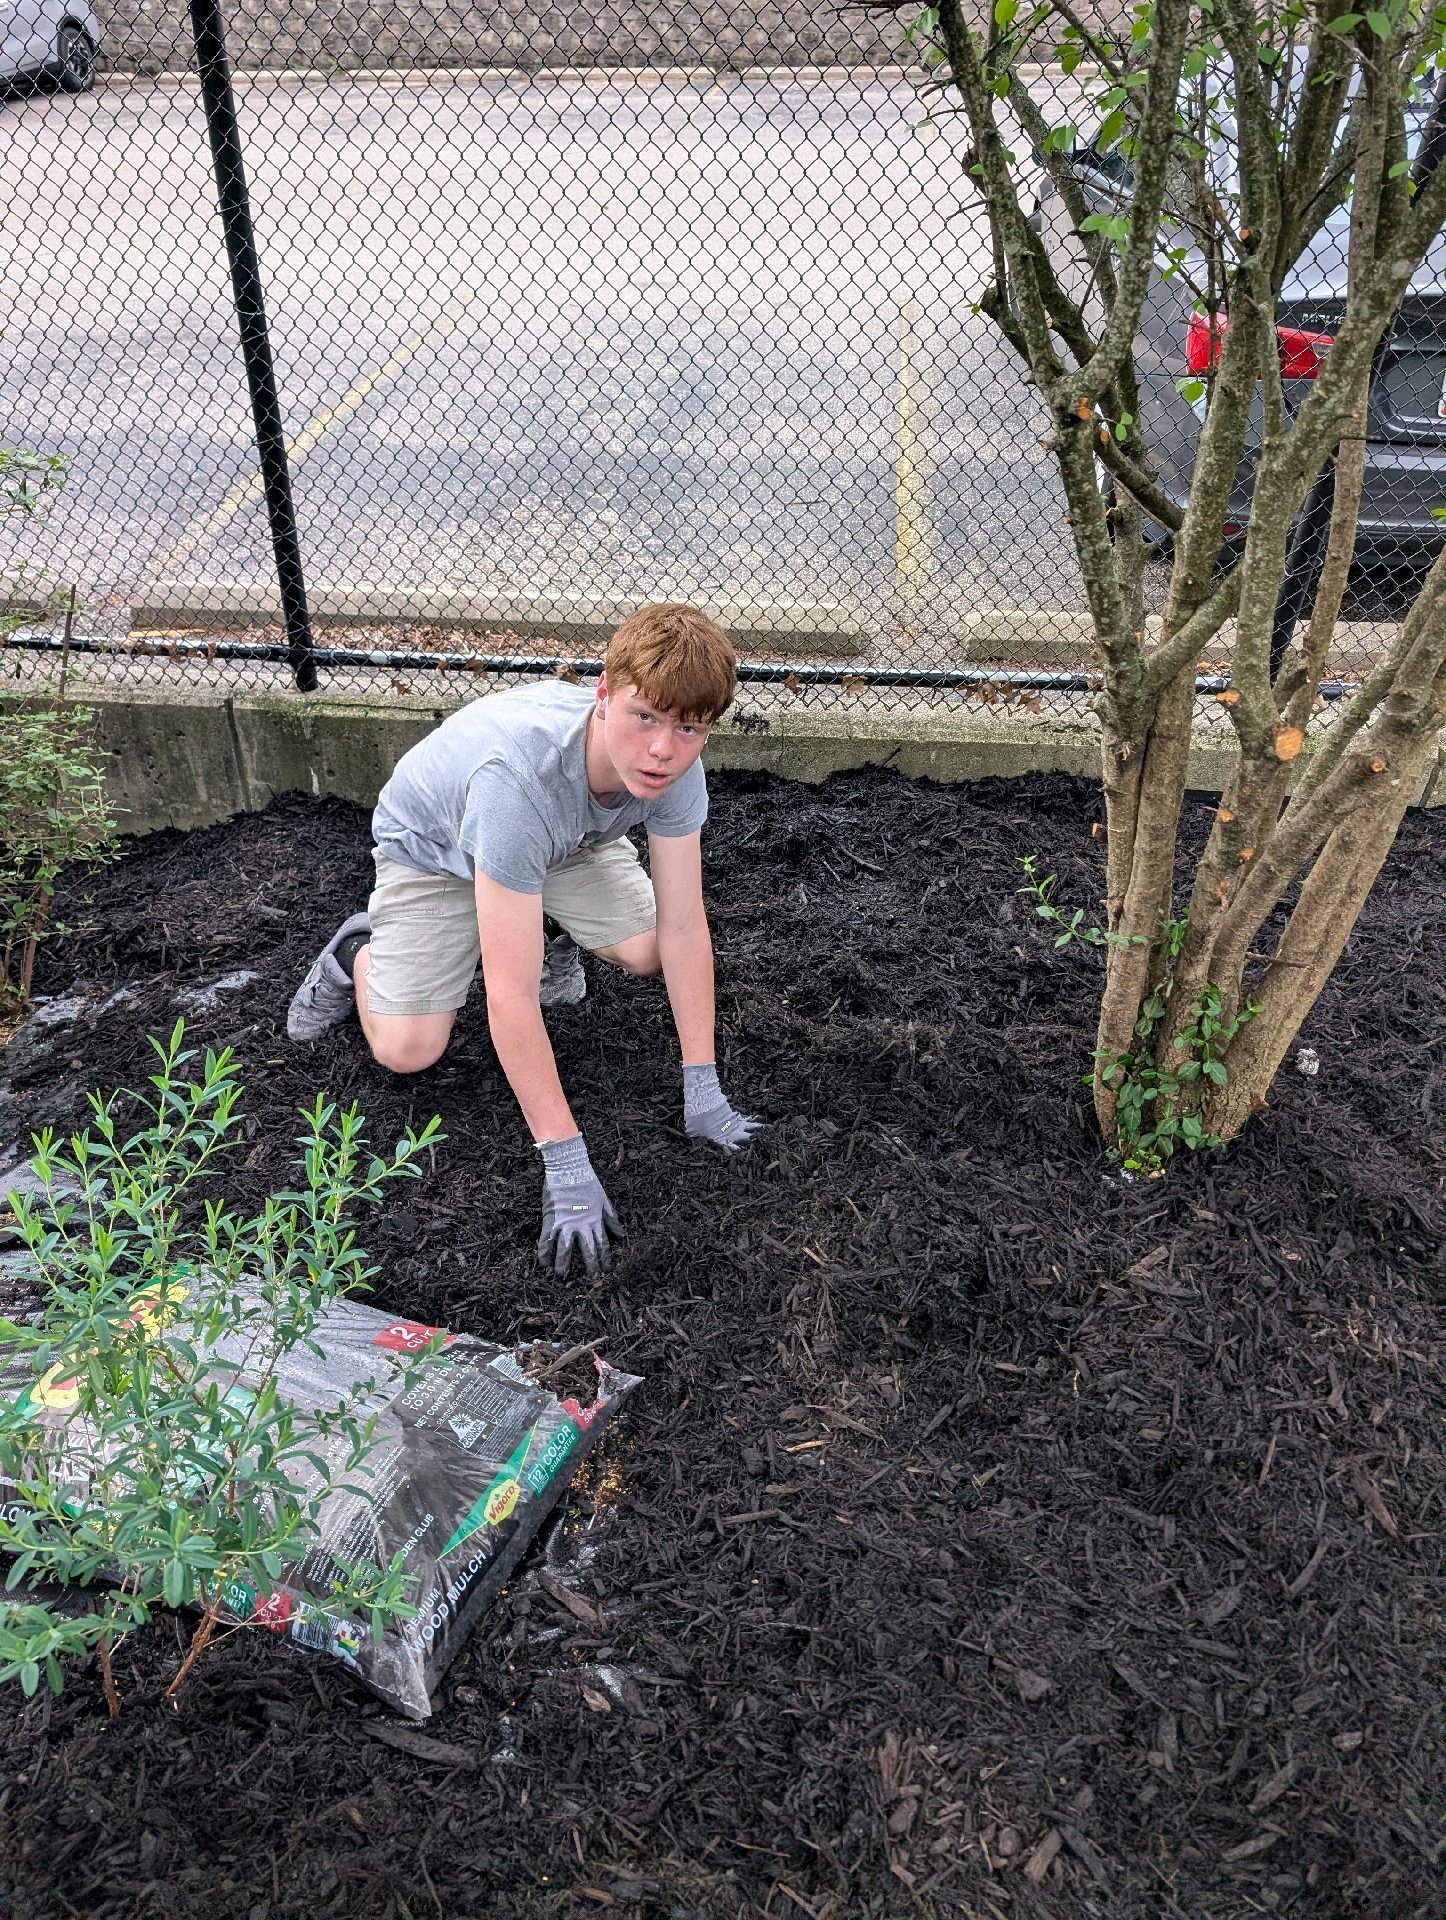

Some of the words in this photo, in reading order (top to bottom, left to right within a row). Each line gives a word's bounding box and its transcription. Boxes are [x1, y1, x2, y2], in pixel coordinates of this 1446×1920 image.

[389, 1321, 417, 1342] 2
[405, 1336, 423, 1349] CU
[408, 1397, 424, 1411] TO
[420, 1383, 436, 1400] 3.0
[413, 1413, 430, 1429] NET
[425, 1377, 460, 1417] CONTENTS
[455, 1370, 465, 1380] 2
[324, 1435, 345, 1458] after
[540, 1423, 573, 1467] COLOR
[548, 1432, 576, 1473] GUARANTEE
[530, 1468, 544, 1484] 12
[486, 1484, 517, 1520] Vigoro
[387, 1535, 419, 1573] GDEN
[413, 1512, 435, 1538] CLUB
[267, 1591, 281, 1611] 2
[403, 1586, 442, 1635] REMIUM
[409, 1601, 452, 1655] WOOD
[444, 1548, 487, 1604] MULCH
